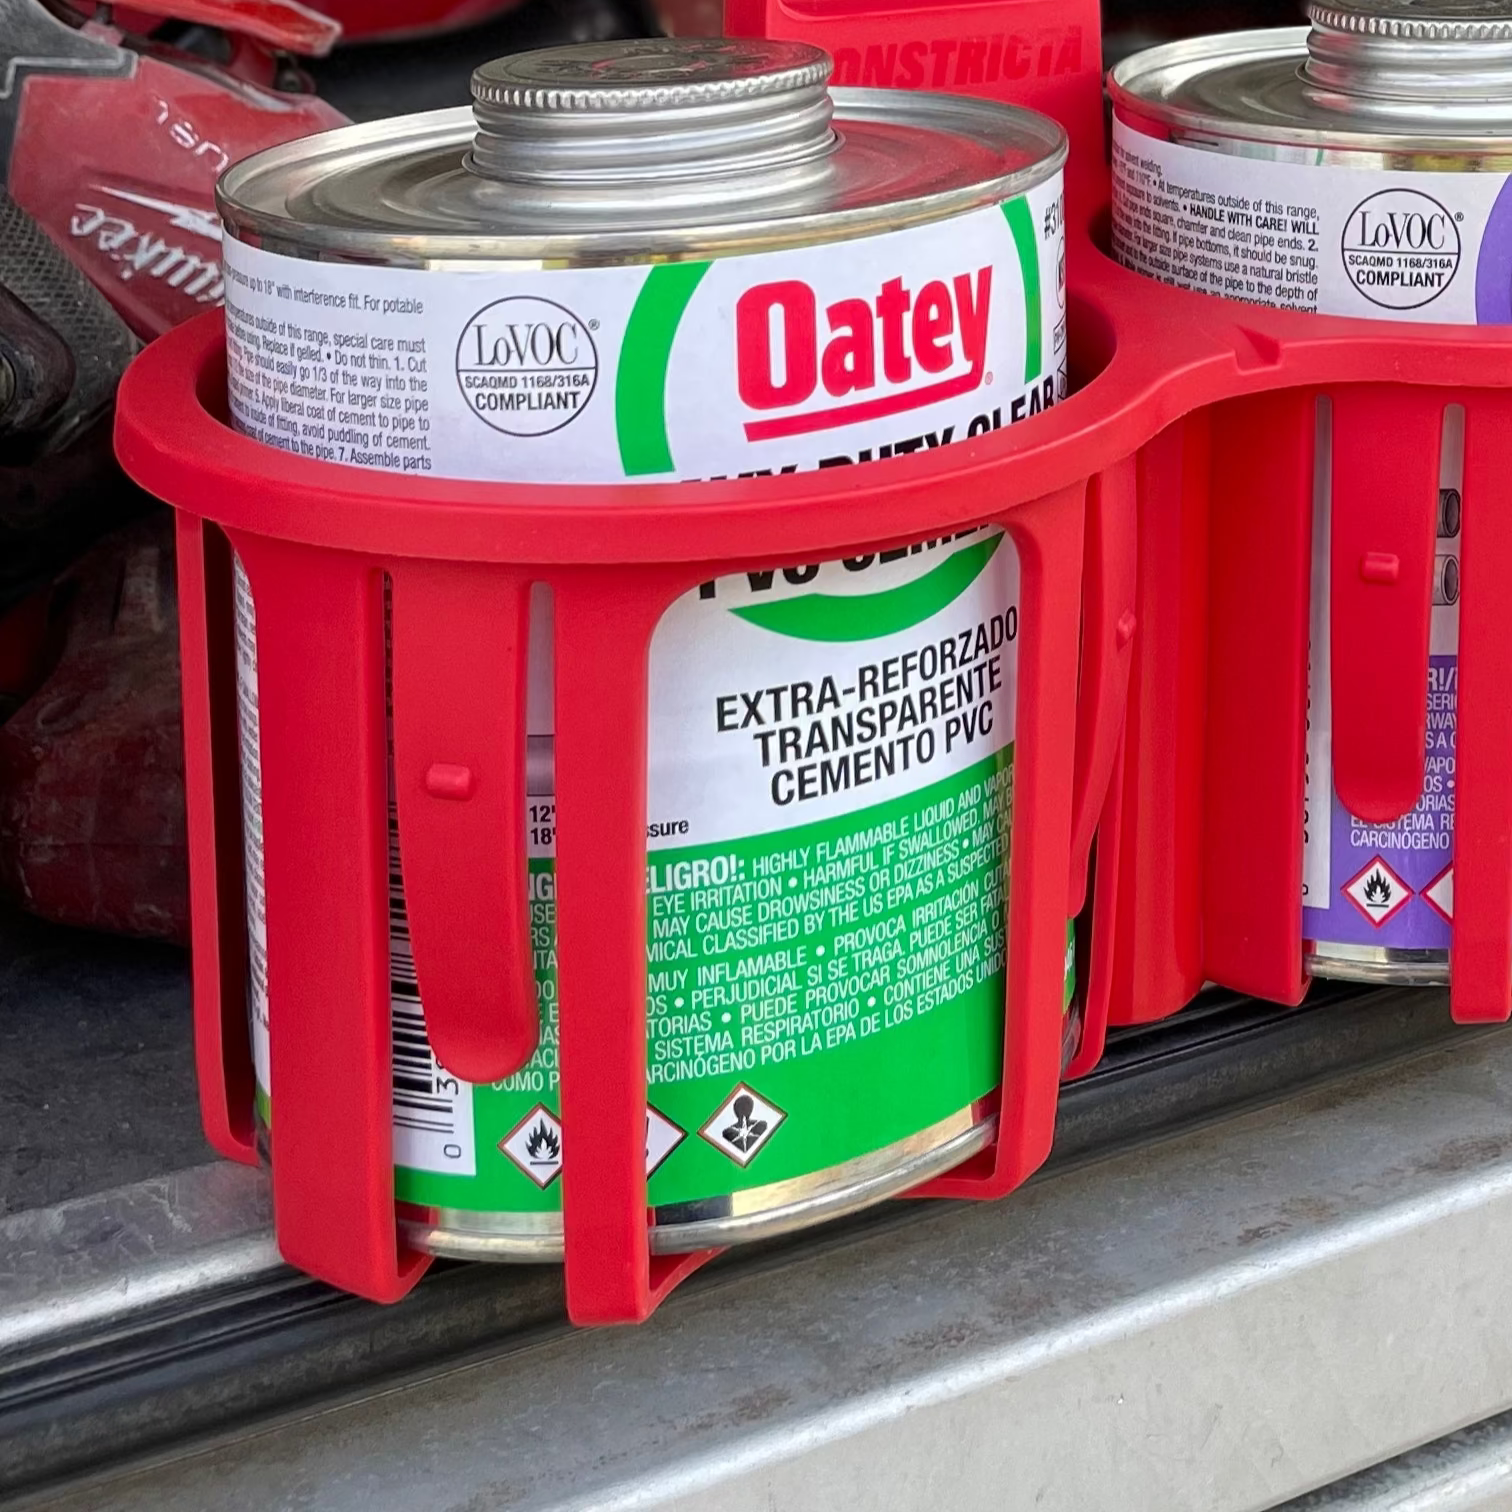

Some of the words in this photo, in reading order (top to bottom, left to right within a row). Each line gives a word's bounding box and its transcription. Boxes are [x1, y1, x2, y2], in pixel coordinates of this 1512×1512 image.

[1167, 182, 1215, 204] temperatures
[1218, 196, 1250, 211] outside
[1265, 200, 1283, 215] this
[1286, 205, 1319, 221] range,
[1177, 217, 1207, 235] chamfer
[1210, 226, 1225, 239] and
[1228, 227, 1251, 242] clean
[1254, 230, 1274, 250] pipe
[1190, 204, 1225, 222] HANDLE
[1228, 211, 1252, 227] WITH
[1256, 216, 1287, 232] CARE!
[1291, 220, 1319, 235] WILL
[1190, 252, 1222, 271] systems
[1250, 263, 1283, 280] natural
[1286, 266, 1318, 284] bristle
[1241, 246, 1272, 262] should
[1274, 251, 1288, 264] be
[1349, 254, 1393, 267] SCAQMD
[1397, 257, 1452, 269] 1168/316A
[1225, 275, 1243, 291] pipe
[1275, 286, 1304, 301] depth
[1357, 270, 1444, 287] COMPLIANT
[294, 287, 345, 308] interference
[364, 295, 380, 311] For
[383, 297, 423, 314] potable
[288, 324, 301, 339] this
[333, 335, 367, 350] special
[371, 336, 393, 350] care
[398, 339, 425, 352] must
[736, 265, 993, 410] Oatey
[335, 350, 347, 365] Do
[350, 352, 366, 368] not
[369, 355, 391, 371] thin.
[408, 357, 427, 373] Cut
[300, 366, 310, 381] go
[330, 369, 339, 382] of
[341, 370, 357, 386] the
[361, 374, 382, 391] way
[385, 377, 405, 391] into
[409, 377, 427, 392] the
[465, 376, 517, 389] SCAQMD
[522, 374, 589, 388] 1168/316A
[281, 396, 304, 414] liberal
[307, 402, 324, 418] coat
[327, 404, 336, 420] of
[338, 409, 376, 427] cement
[379, 412, 389, 428] to
[392, 415, 414, 433] pipe
[419, 416, 429, 431] to
[331, 389, 345, 403] For
[348, 390, 377, 410] larger
[380, 394, 401, 409] size
[405, 399, 428, 414] pipe
[475, 391, 580, 410] COMPLIANT
[302, 422, 324, 439] avoid
[328, 428, 368, 448] puddling
[372, 431, 382, 446] of
[386, 435, 430, 450] cement.
[351, 448, 400, 467] Assemble
[403, 455, 432, 471] parts
[716, 605, 1018, 733] EXTRA-REFORZADO
[753, 656, 1002, 767] TRANSPARENTE
[771, 727, 935, 806] CEMENTO
[945, 700, 993, 754] PVC
[753, 846, 810, 877] HIGHLY
[817, 816, 909, 862] FLAMMABLE
[914, 798, 954, 831] LIQUID
[957, 784, 981, 812] AND
[1350, 827, 1450, 850] CARCINÓGENO
[653, 916, 690, 938] MAY
[696, 905, 753, 933] CAUSE
[758, 876, 866, 923] DROWSINESS
[894, 839, 958, 883] DIZZINESS
[691, 877, 782, 911] IRRITATION
[804, 849, 879, 888] HARMFUL
[702, 918, 799, 955] CLASSIFIED
[828, 901, 859, 927] THE
[887, 878, 914, 909] EPA
[947, 832, 1008, 882] SUSPECTED
[649, 969, 688, 992] MUY
[697, 946, 807, 986] INFLAMABLE
[834, 915, 906, 955] PROVOCA
[692, 971, 802, 1010] PERJUDICIAL
[909, 916, 952, 951] PUEDE
[956, 903, 977, 930] SER
[741, 993, 797, 1023] PUEDE
[806, 965, 890, 1009] PROVOCAR
[897, 919, 987, 978] SOMNOLENCIA
[655, 1031, 734, 1061] SISTEMA
[741, 998, 860, 1047] RESPIRATORIO
[884, 960, 950, 1006] CONTIENE
[956, 946, 980, 973] UNA
[761, 1040, 796, 1065] POR
[826, 1022, 856, 1049] EPA
[885, 1000, 913, 1028] LOS
[917, 970, 974, 1015] ESTADOS
